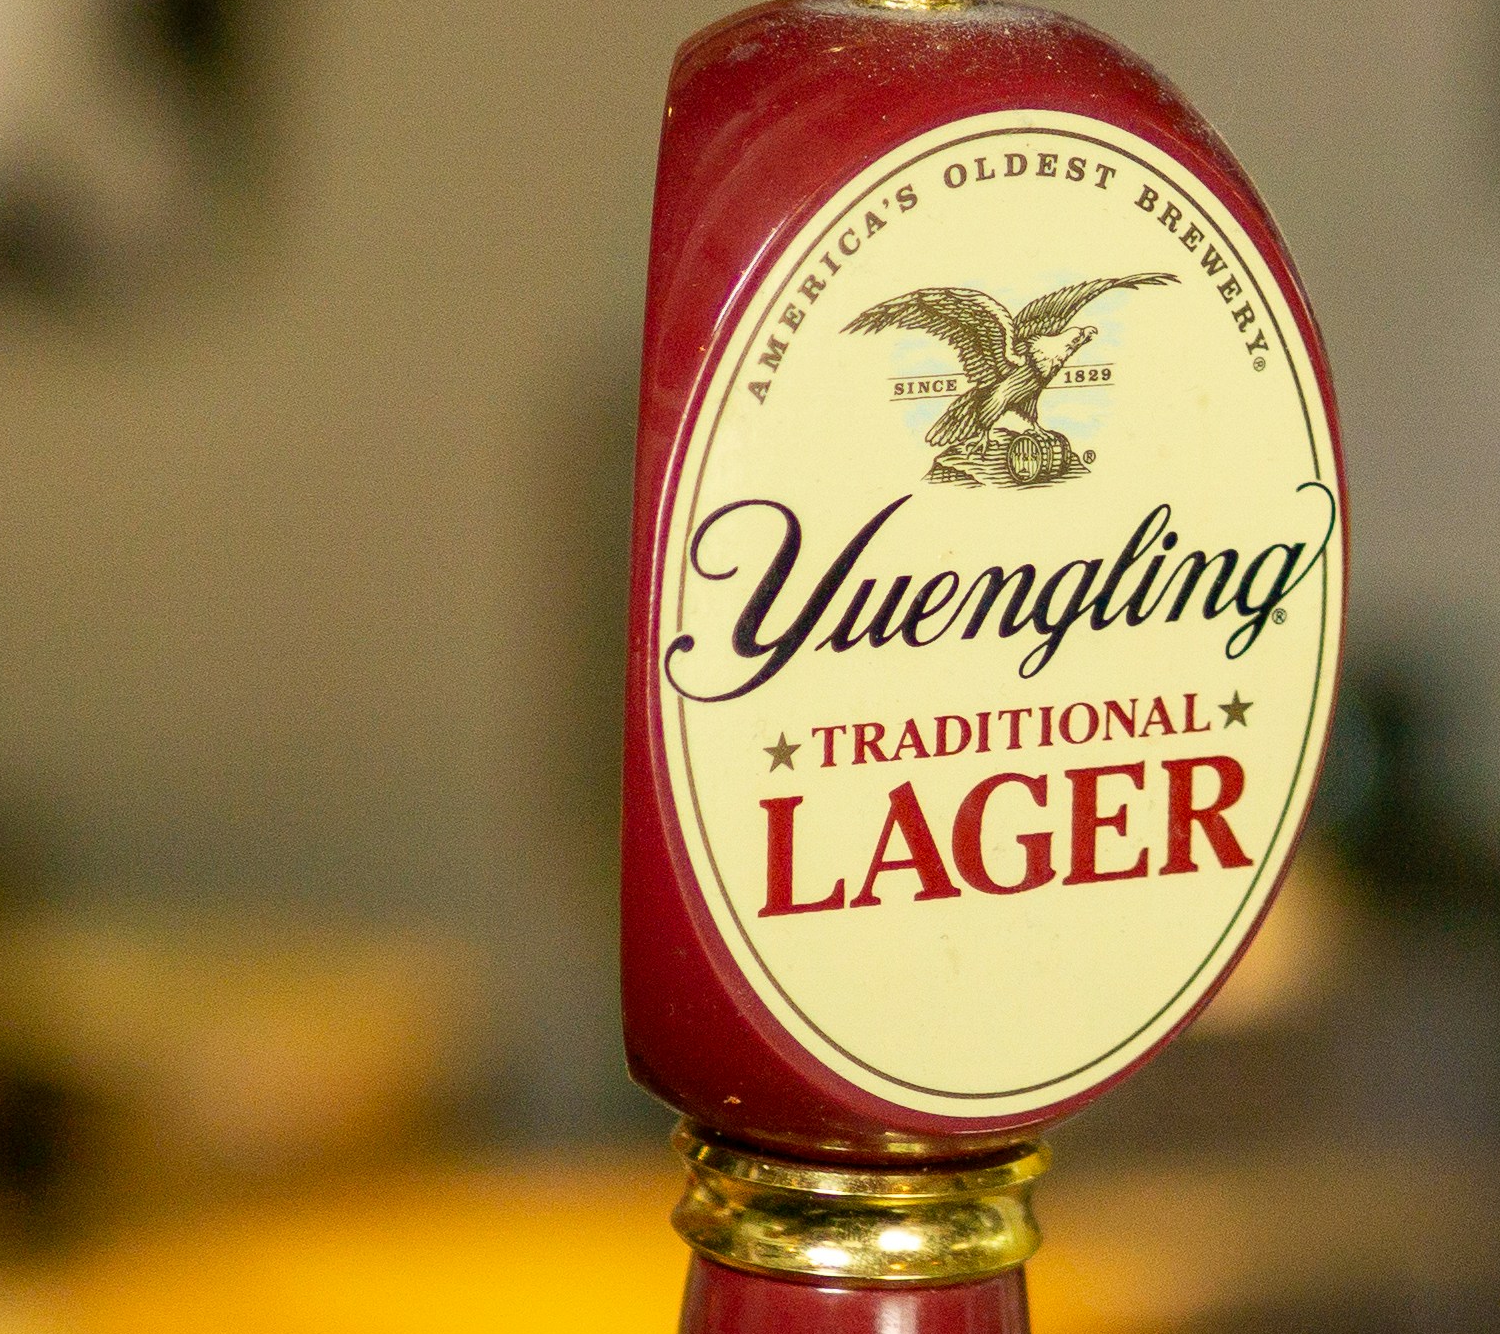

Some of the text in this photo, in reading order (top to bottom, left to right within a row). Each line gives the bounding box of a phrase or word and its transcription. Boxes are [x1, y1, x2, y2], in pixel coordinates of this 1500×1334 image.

[748, 185, 918, 405] AMERICA'S
[943, 152, 1118, 188] OLDEST
[894, 367, 1114, 397] SINCE 1829
[813, 694, 1211, 768] TRADITIONAL
[759, 755, 1252, 918] LAGER
